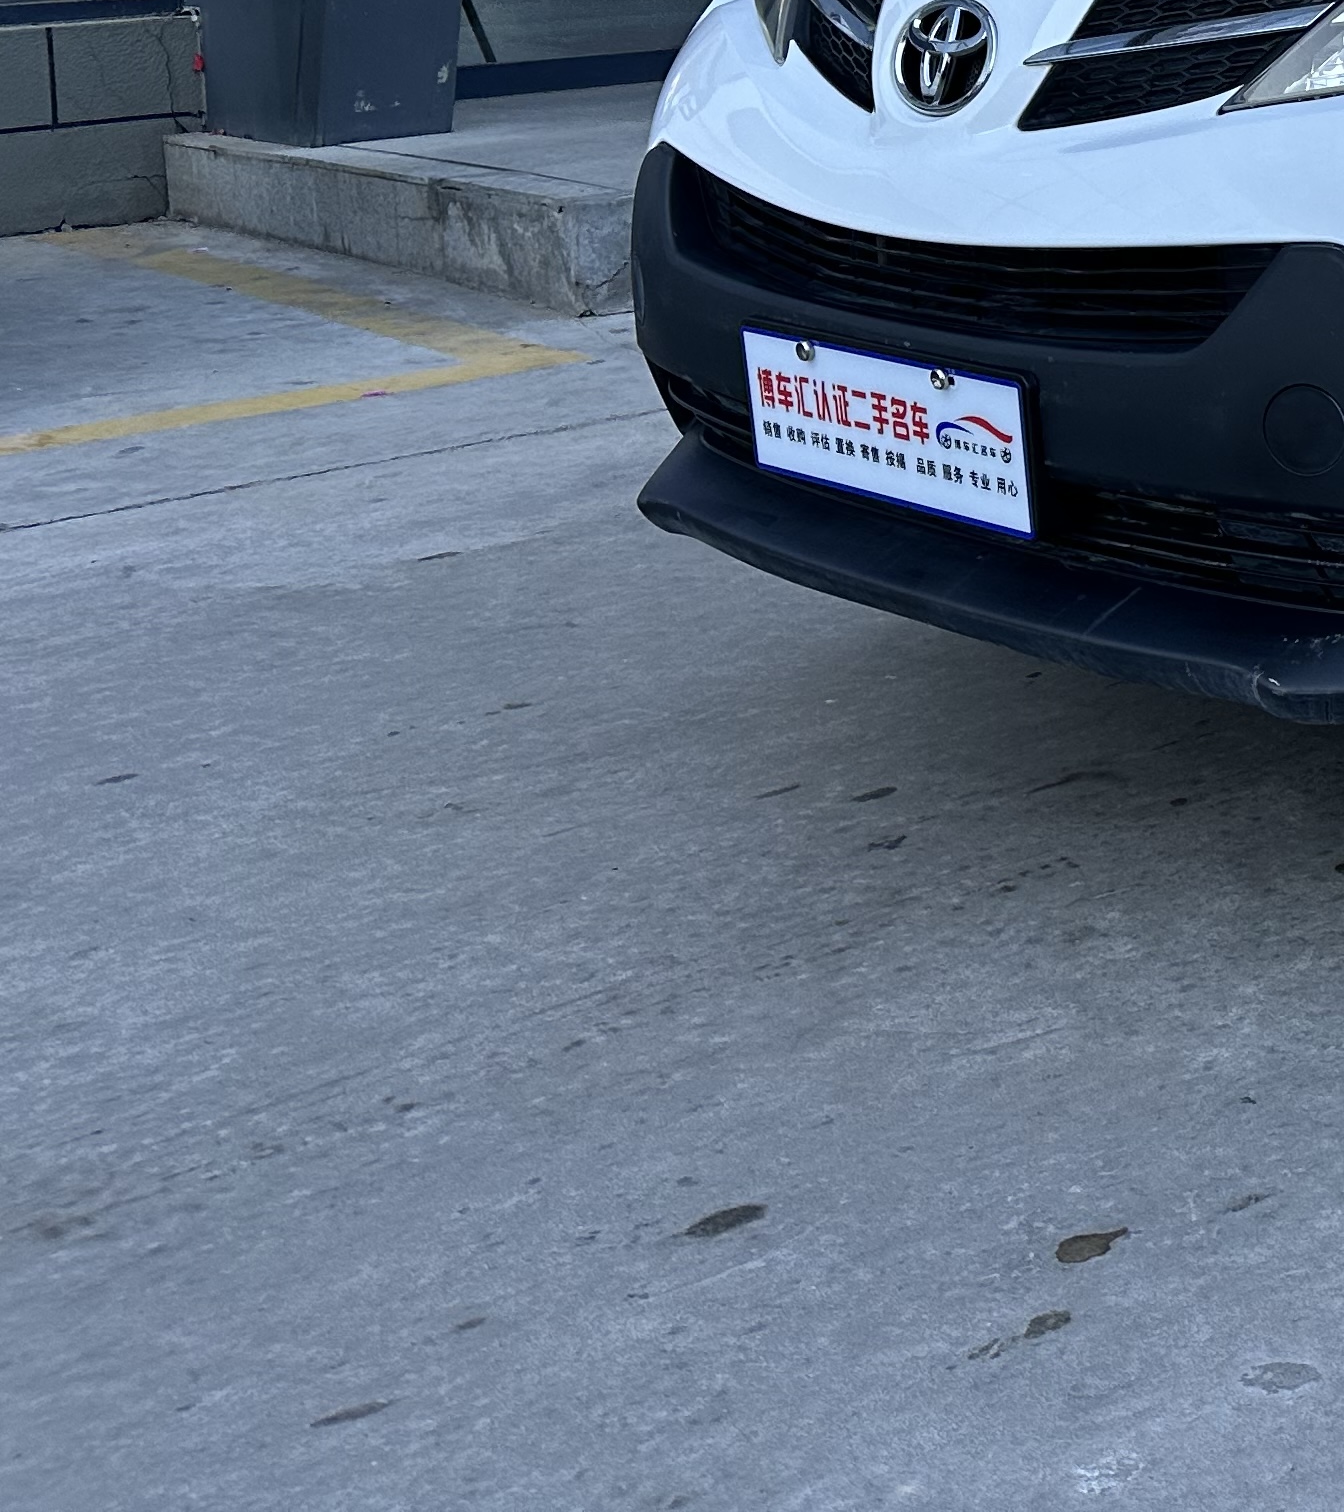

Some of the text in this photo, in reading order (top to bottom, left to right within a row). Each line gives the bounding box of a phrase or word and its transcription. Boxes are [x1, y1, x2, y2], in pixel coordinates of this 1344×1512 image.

[757, 367, 930, 445] 博车汇认证二手名车
[763, 419, 782, 439] 销售
[786, 425, 806, 445] 收购
[811, 431, 831, 451] 评估
[835, 437, 856, 457] 置换
[916, 457, 937, 477] 品质
[942, 463, 964, 484] 服务
[969, 470, 992, 491] 专业
[996, 477, 1019, 497] 用心
